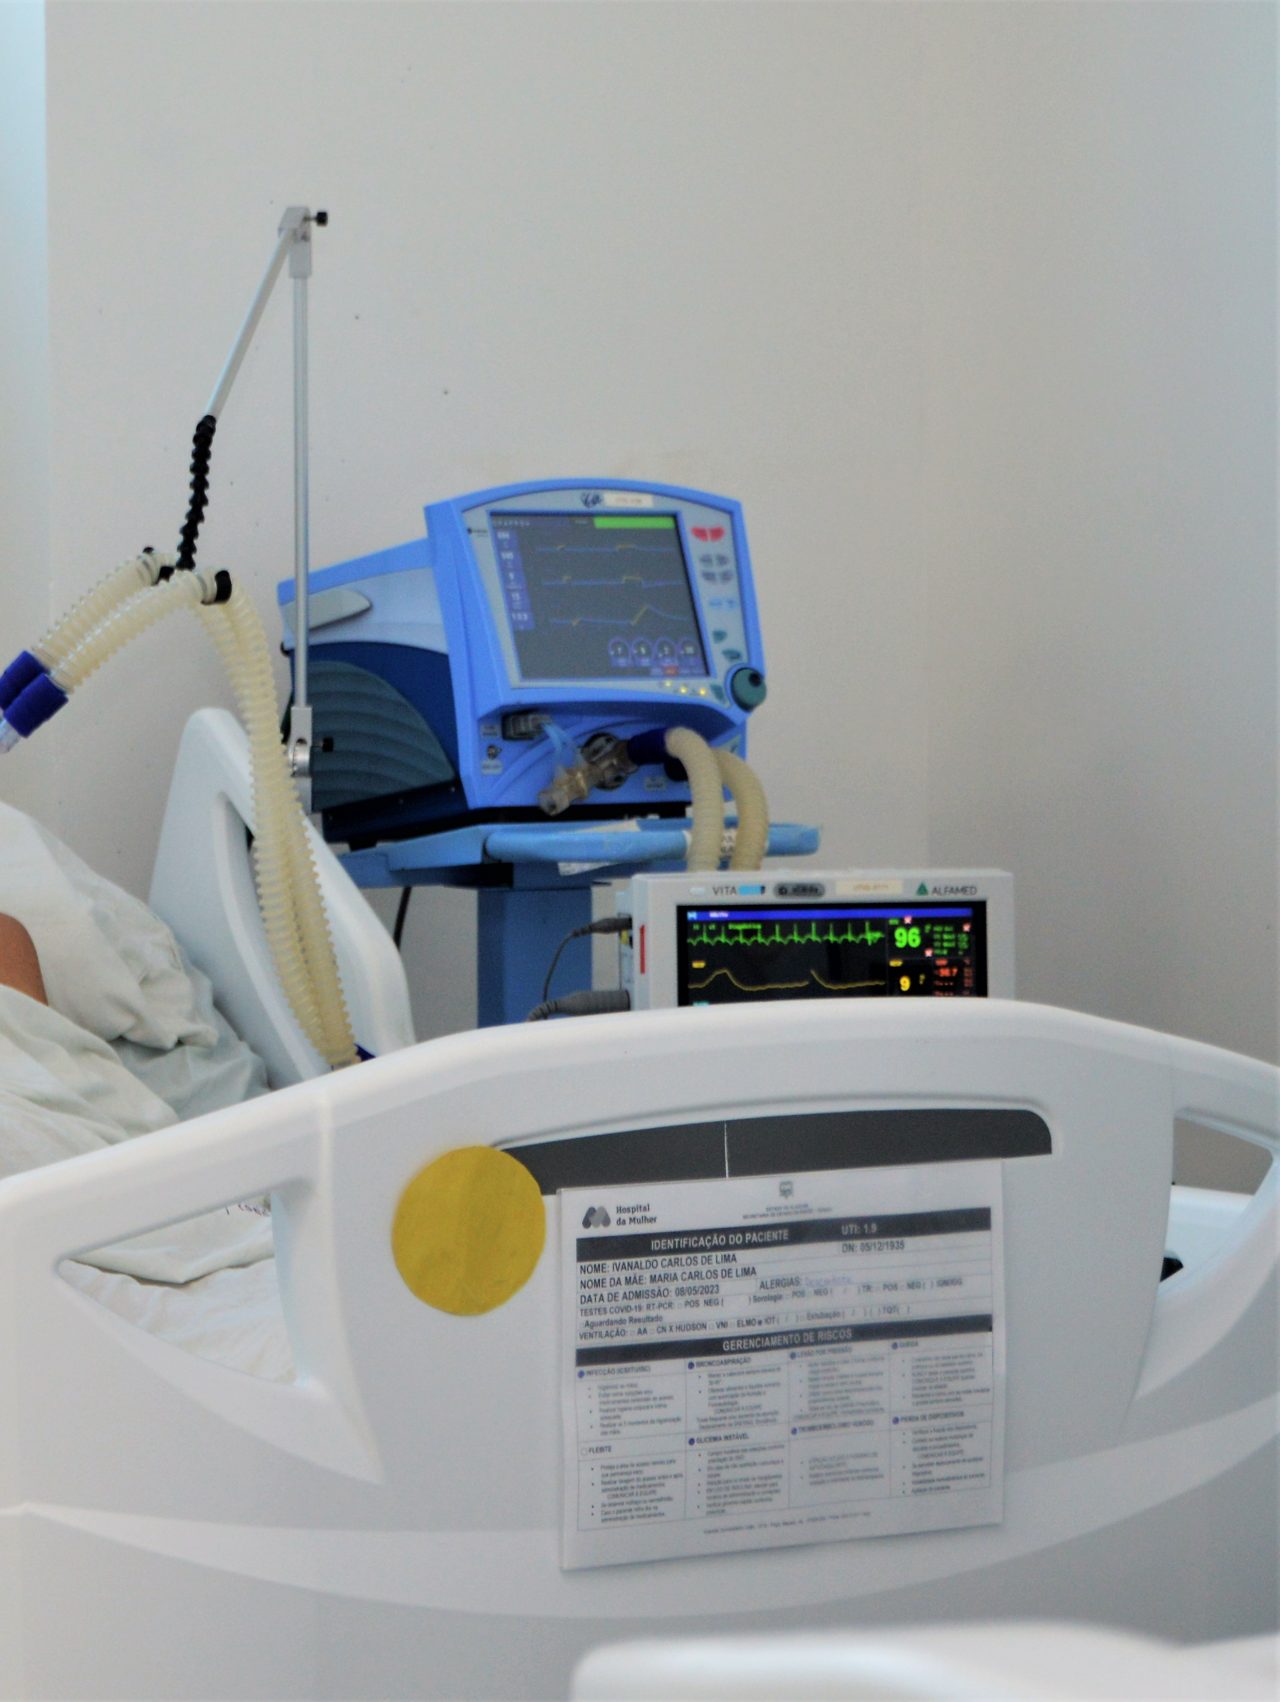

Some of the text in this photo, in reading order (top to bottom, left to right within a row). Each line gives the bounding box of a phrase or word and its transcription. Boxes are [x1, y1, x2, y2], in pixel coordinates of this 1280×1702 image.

[712, 886, 737, 896] VITA
[932, 886, 977, 896] ALFAMED
[894, 926, 921, 948] 96
[899, 975, 911, 991] 9
[616, 1203, 650, 1215] Hospital
[616, 1214, 657, 1226] da Mulher
[651, 1229, 789, 1251] IDENTIFICAÇÃO DO PACIENTE
[580, 1253, 737, 1275] NOME: IVANALDO CARLOS DE LIMA
[580, 1278, 607, 1289] NOME
[609, 1277, 622, 1288] DA
[649, 1272, 678, 1284] MARIA
[681, 1269, 718, 1281] CARLOS
[720, 1268, 733, 1279] DE
[735, 1266, 757, 1278] LIMA
[580, 1284, 720, 1305] DATA DE ADMISSÃO: 08/05/2023
[580, 1307, 607, 1317] TESTES
[584, 1314, 663, 1330] Aguardando Resultado
[637, 1327, 648, 1336] AA
[676, 1322, 707, 1332] HUDSON
[737, 1318, 757, 1328] ELMO
[723, 1328, 852, 1351] GERENCIAMENTO DE RISCOS
